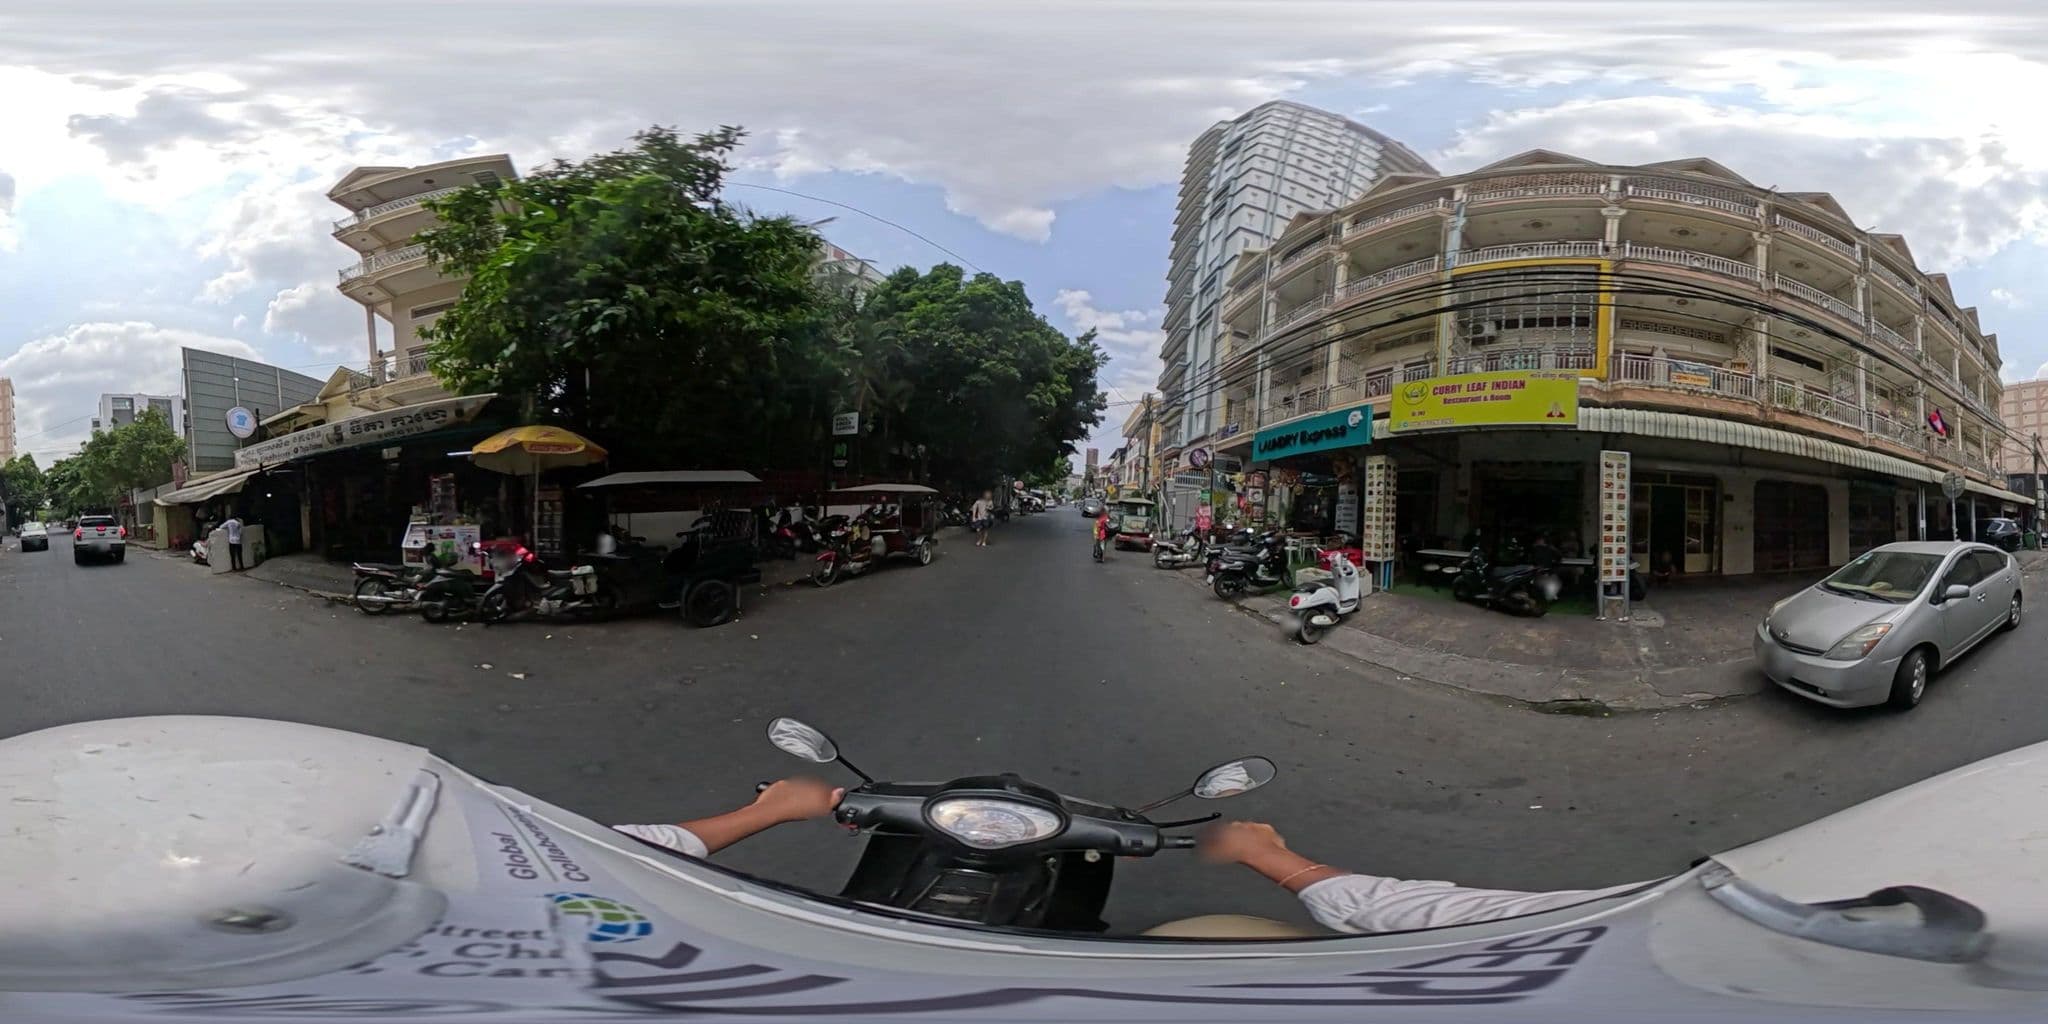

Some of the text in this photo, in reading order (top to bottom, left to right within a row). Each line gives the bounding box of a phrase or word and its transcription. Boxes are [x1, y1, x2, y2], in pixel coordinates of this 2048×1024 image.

[1433, 379, 1525, 396] CURRY LEAF INDIAN
[1299, 425, 1347, 446] Express
[491, 831, 539, 880] Global
